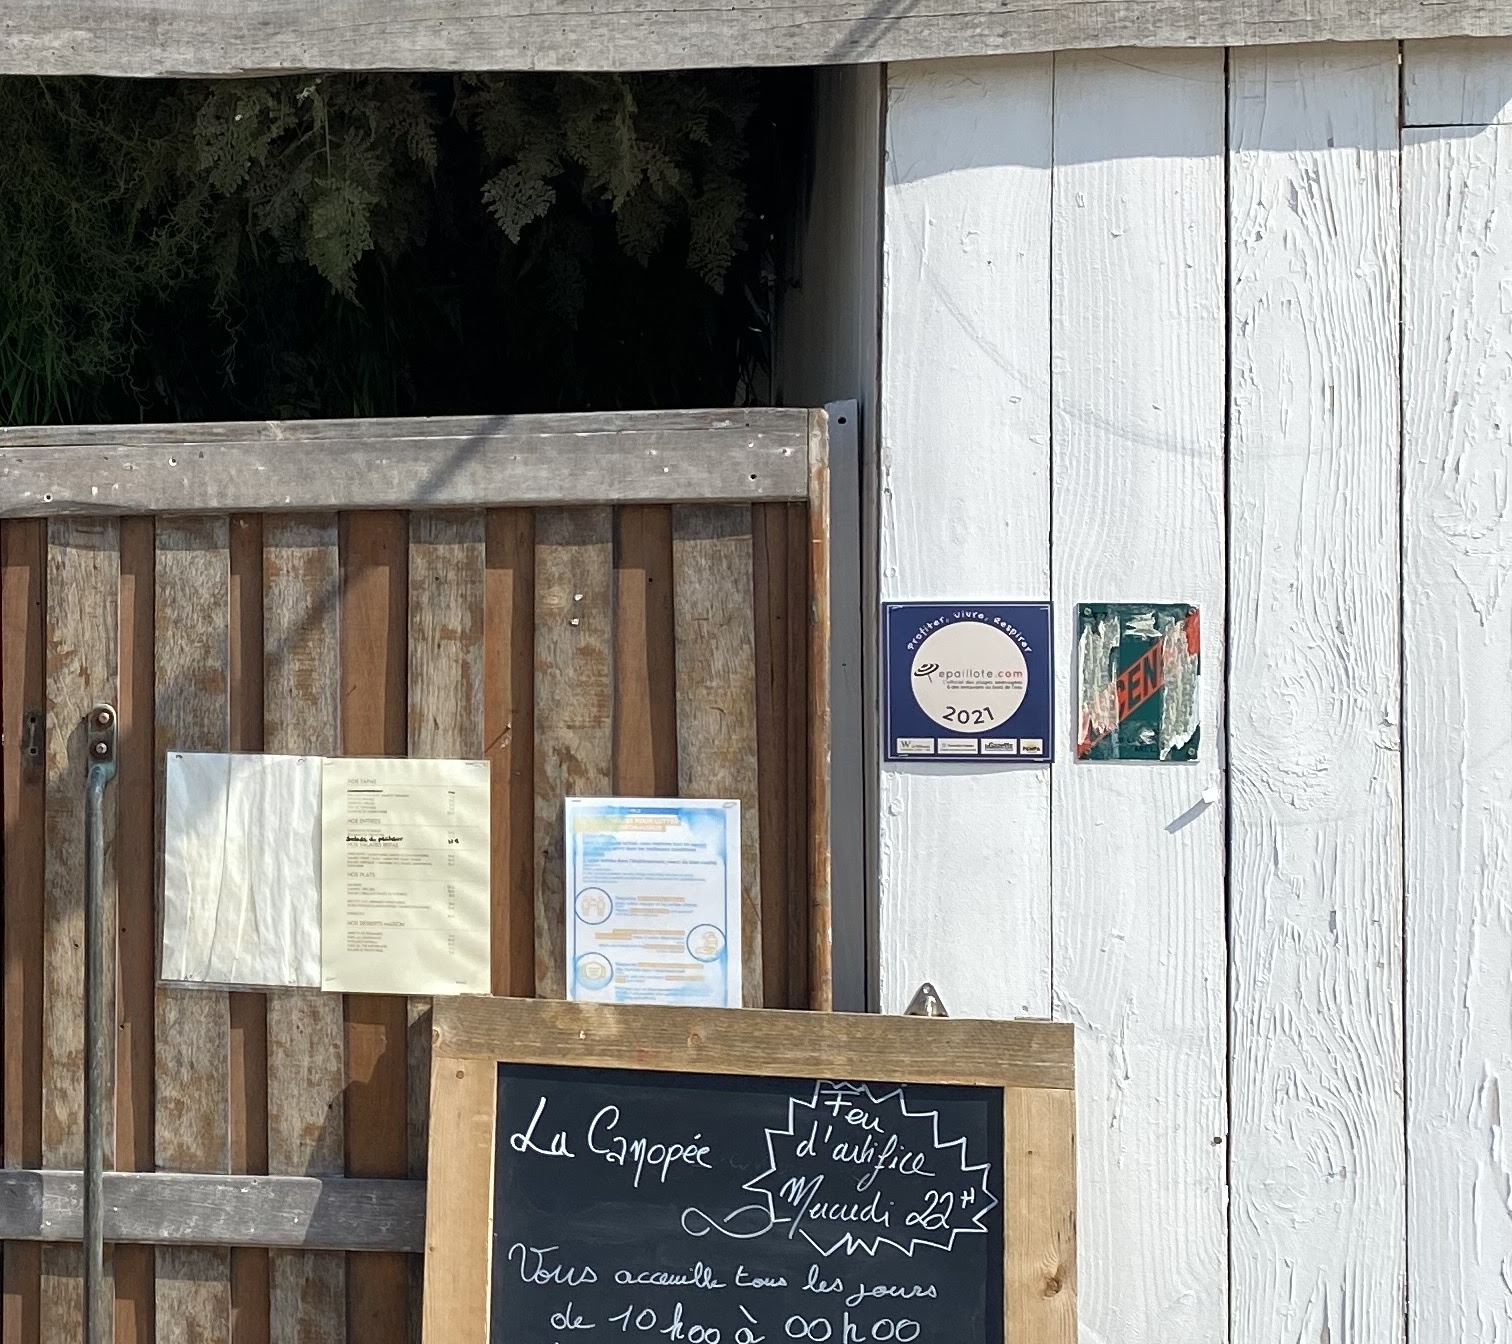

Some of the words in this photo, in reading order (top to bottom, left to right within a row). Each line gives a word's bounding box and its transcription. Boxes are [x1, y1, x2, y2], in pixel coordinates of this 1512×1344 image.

[993, 616, 1033, 653] Respirer
[938, 668, 1024, 681] epaillote.com
[941, 706, 995, 725] 2021
[820, 1090, 885, 1134] Feu
[510, 1096, 576, 1158] La
[587, 1105, 713, 1188] Canopée
[508, 1242, 599, 1286] Vous
[734, 1264, 788, 1288] tous
[801, 1263, 844, 1293] les
[845, 1283, 938, 1307] jours
[550, 1301, 596, 1330] de
